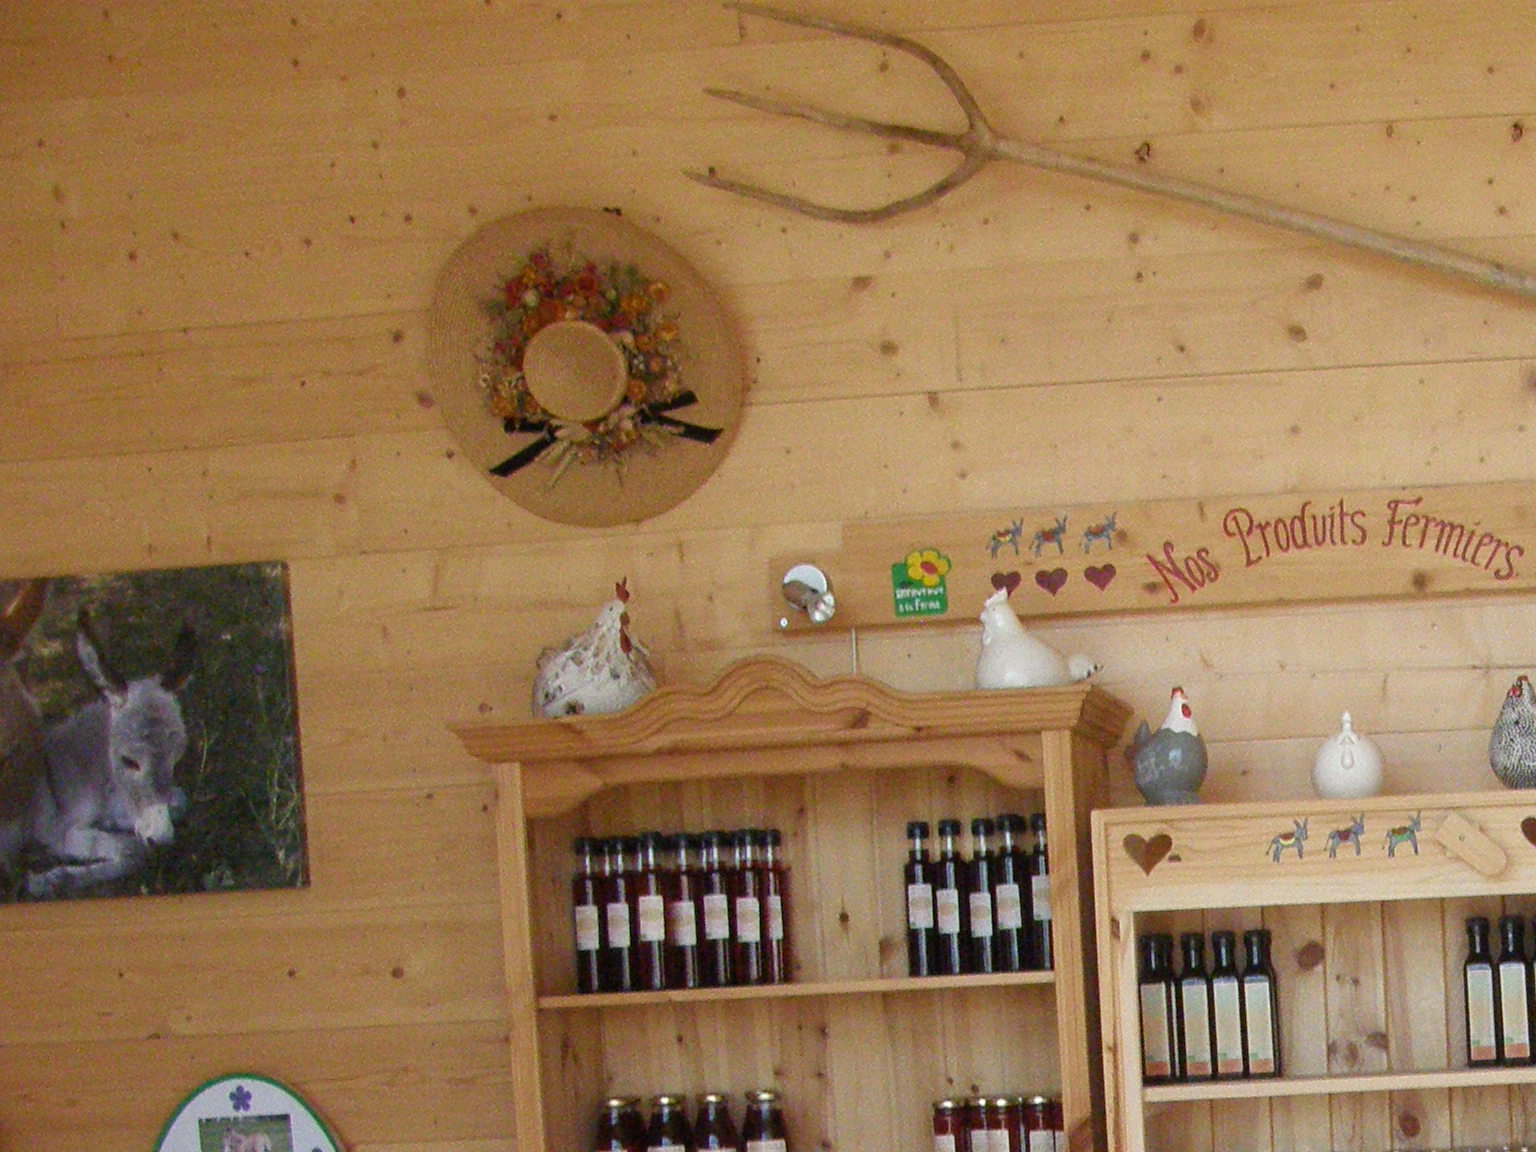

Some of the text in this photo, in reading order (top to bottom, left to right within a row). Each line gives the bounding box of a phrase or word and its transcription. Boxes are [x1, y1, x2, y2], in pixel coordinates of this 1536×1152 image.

[1147, 497, 1525, 603] Nos Produits Fermiers
